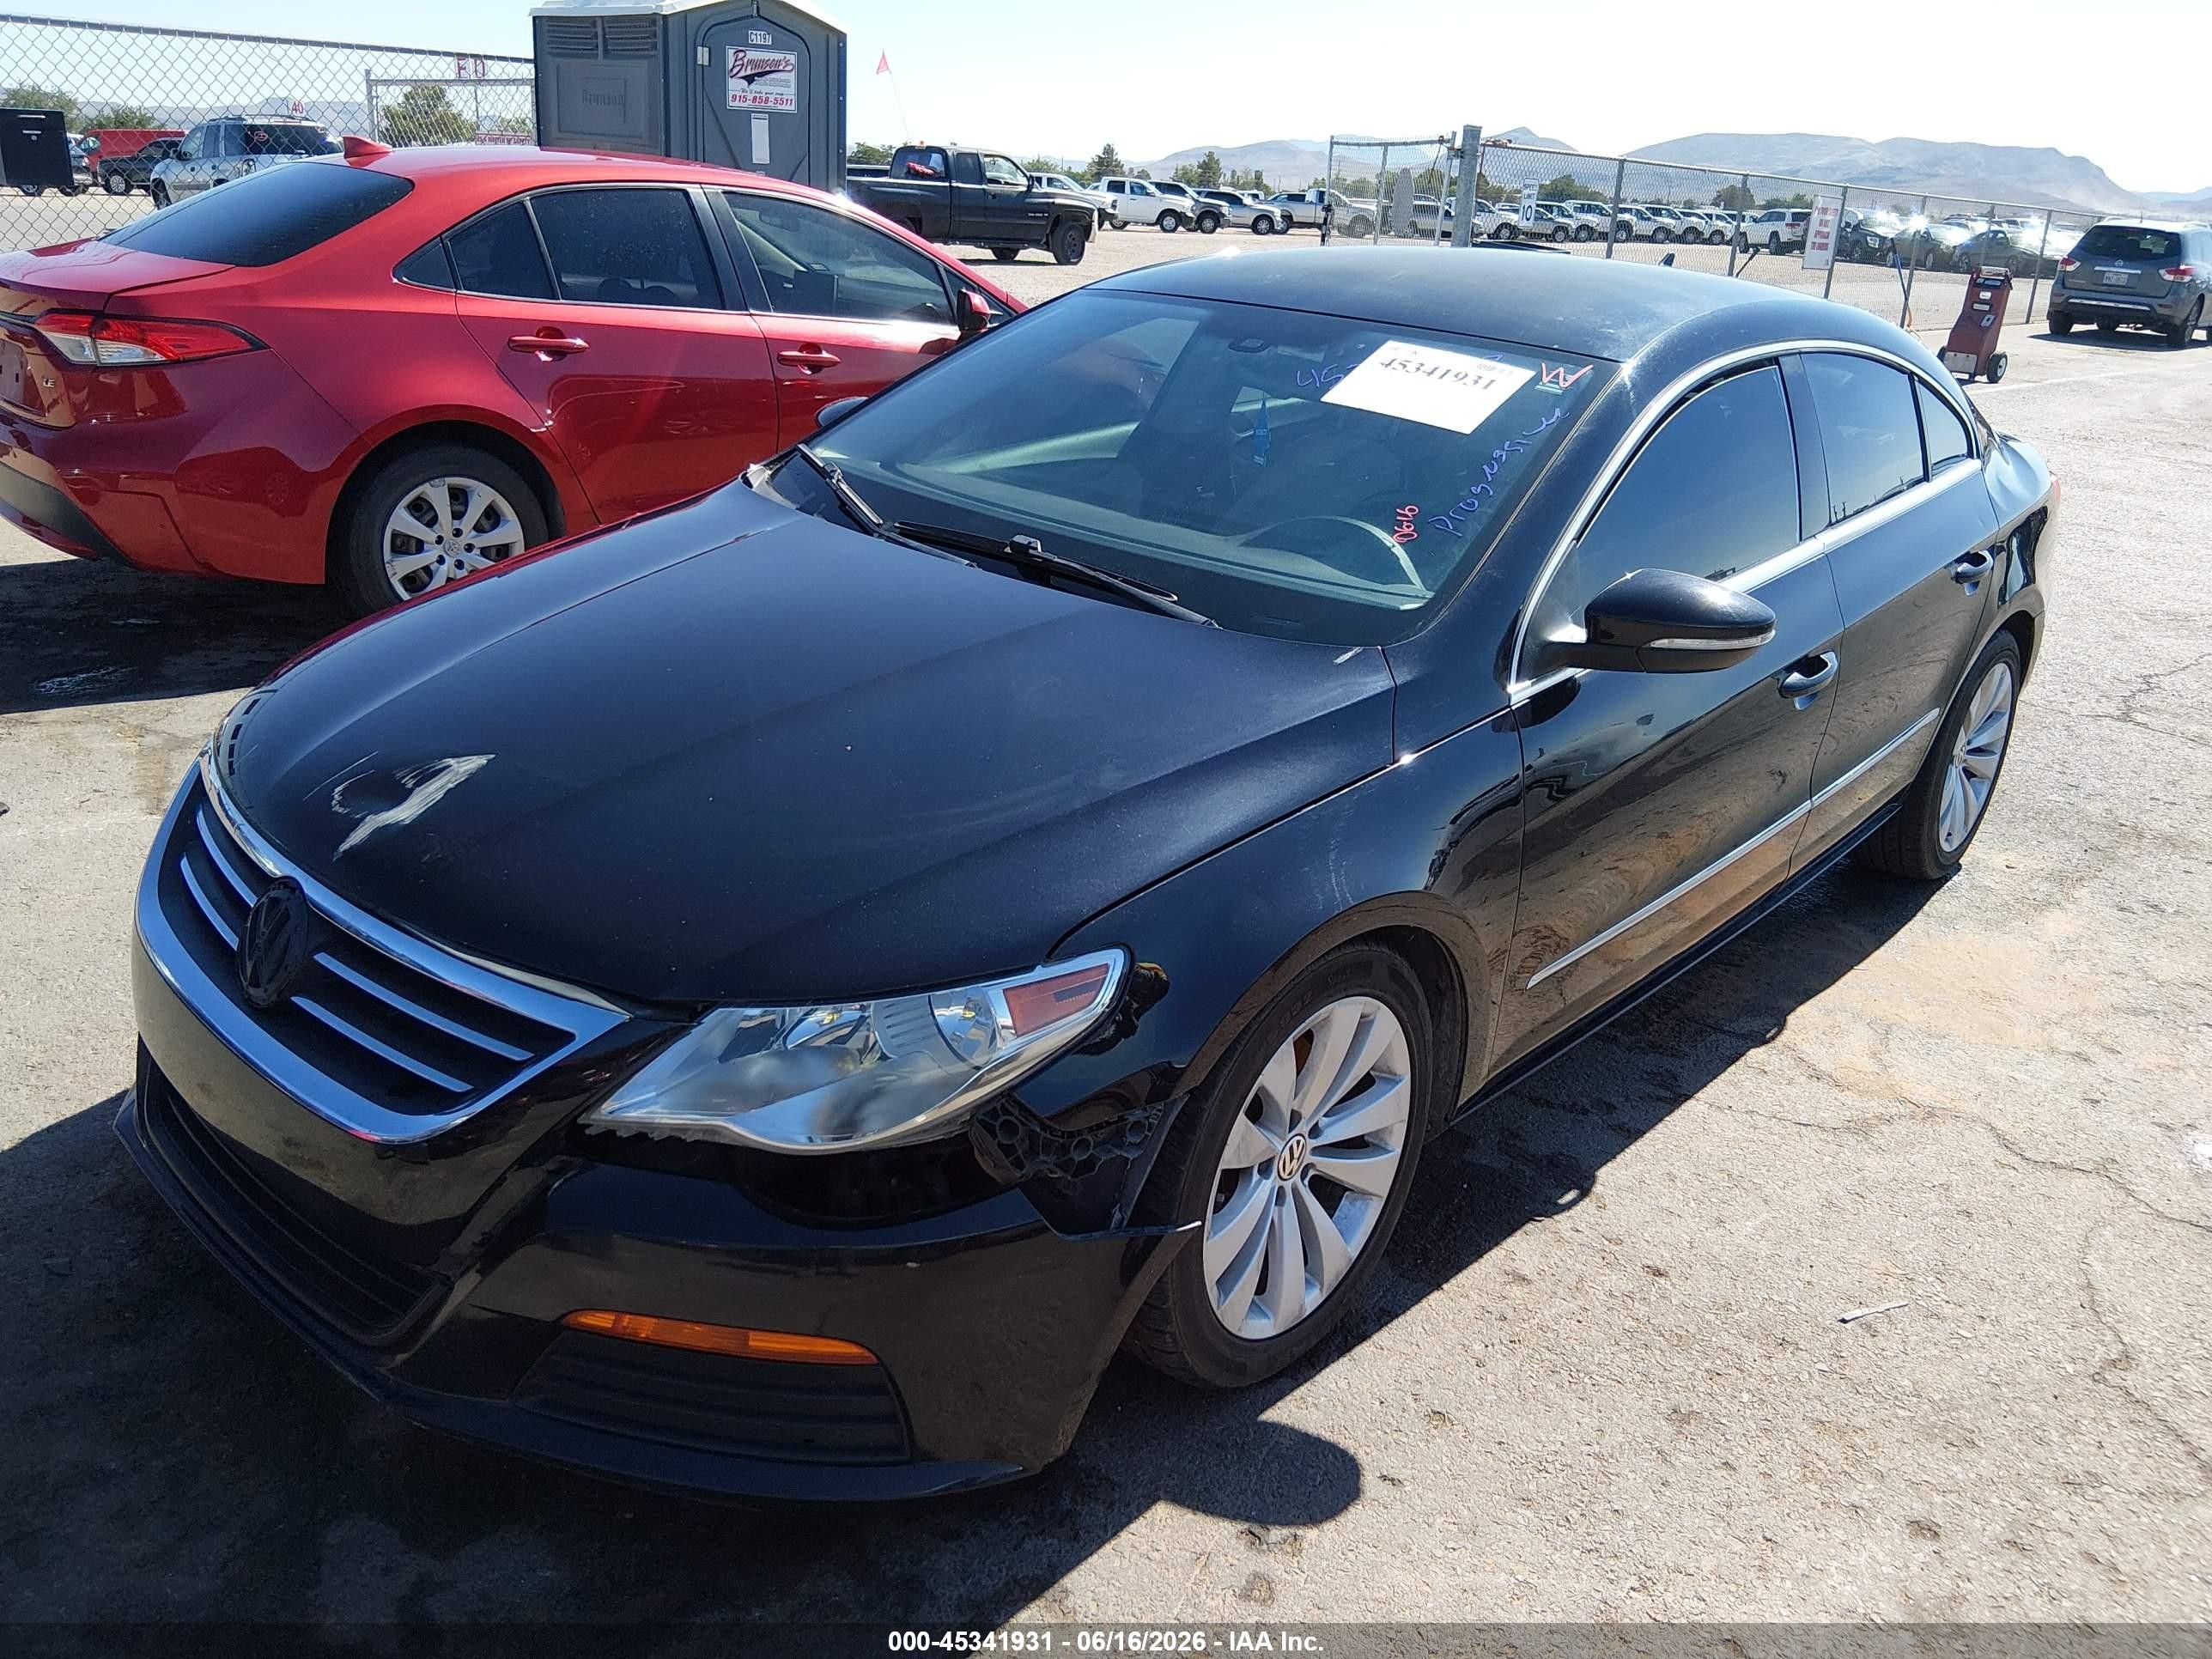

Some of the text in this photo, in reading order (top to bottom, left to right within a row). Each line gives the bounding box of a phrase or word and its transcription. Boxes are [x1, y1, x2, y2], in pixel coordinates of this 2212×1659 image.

[750, 32, 771, 44] C1197
[729, 49, 795, 78] Brunson's
[731, 94, 793, 106] 915-858-5511
[1523, 183, 1538, 191] SPEED
[1522, 204, 1533, 222] 10
[1379, 357, 1498, 392] 45341931
